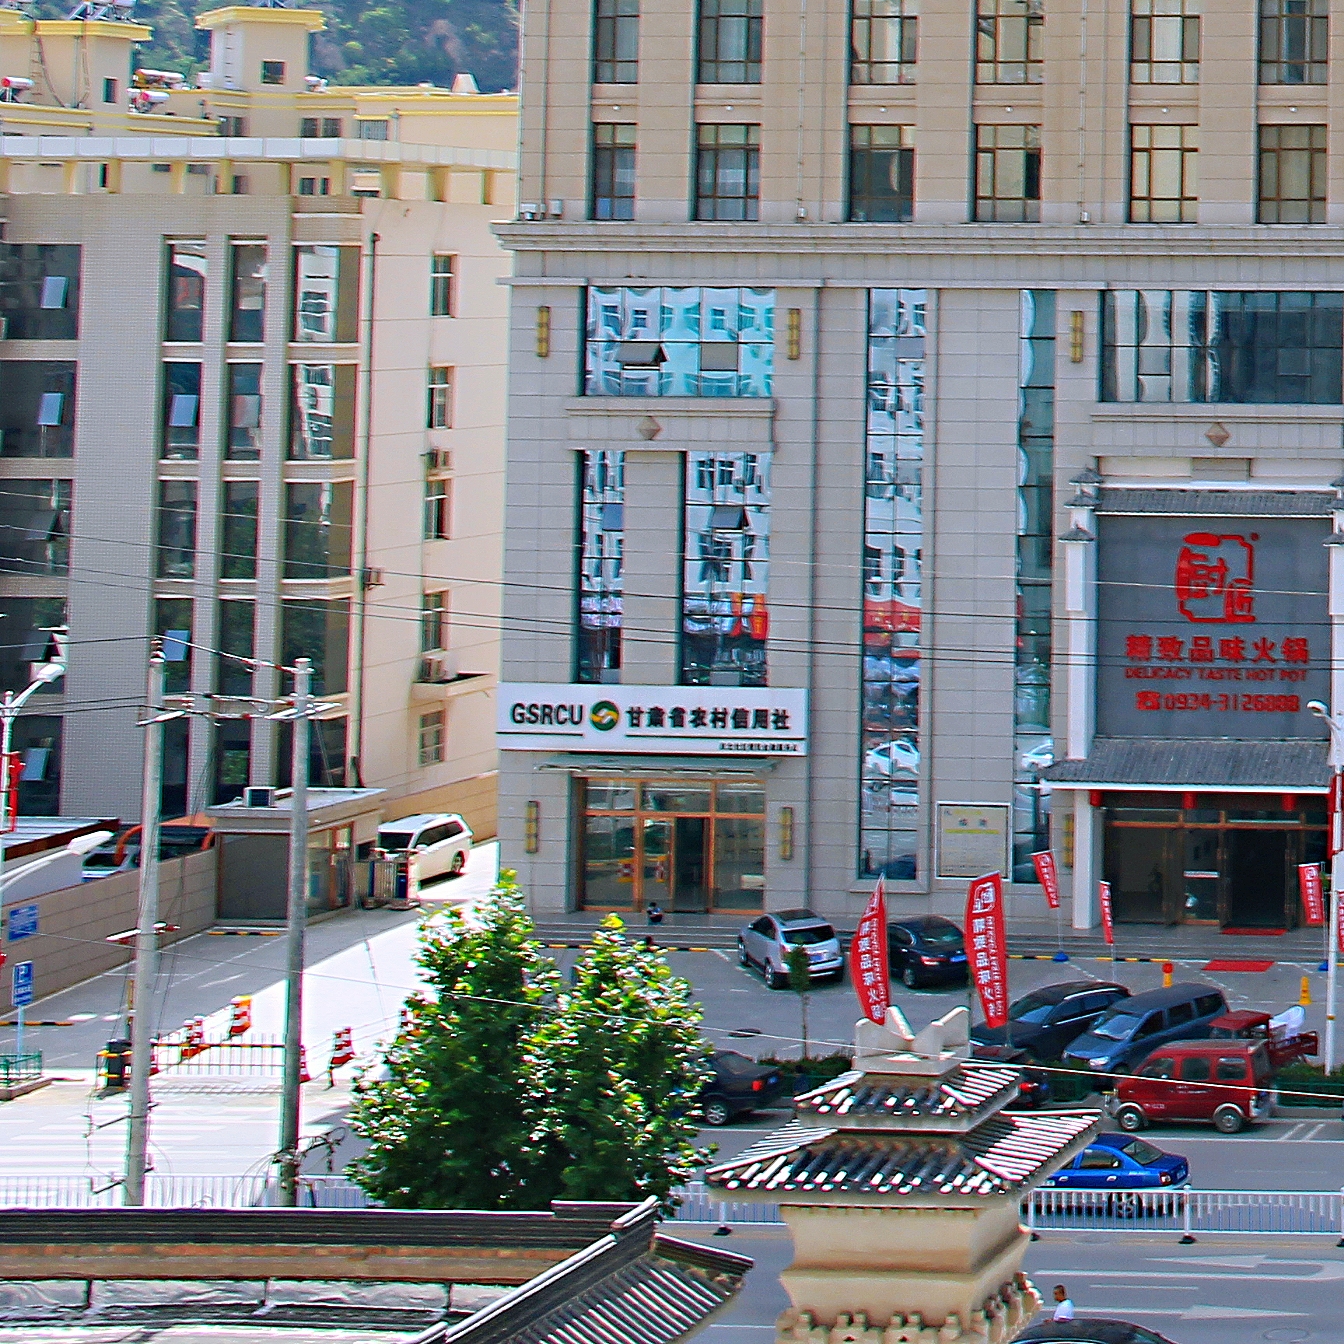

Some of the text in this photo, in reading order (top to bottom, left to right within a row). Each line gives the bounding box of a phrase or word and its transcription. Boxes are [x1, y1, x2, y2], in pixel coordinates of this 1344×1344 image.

[1125, 635, 1310, 664] 精致品味火锅
[511, 703, 584, 725] GSRCU
[626, 706, 791, 730] 甘肃省农村信用社
